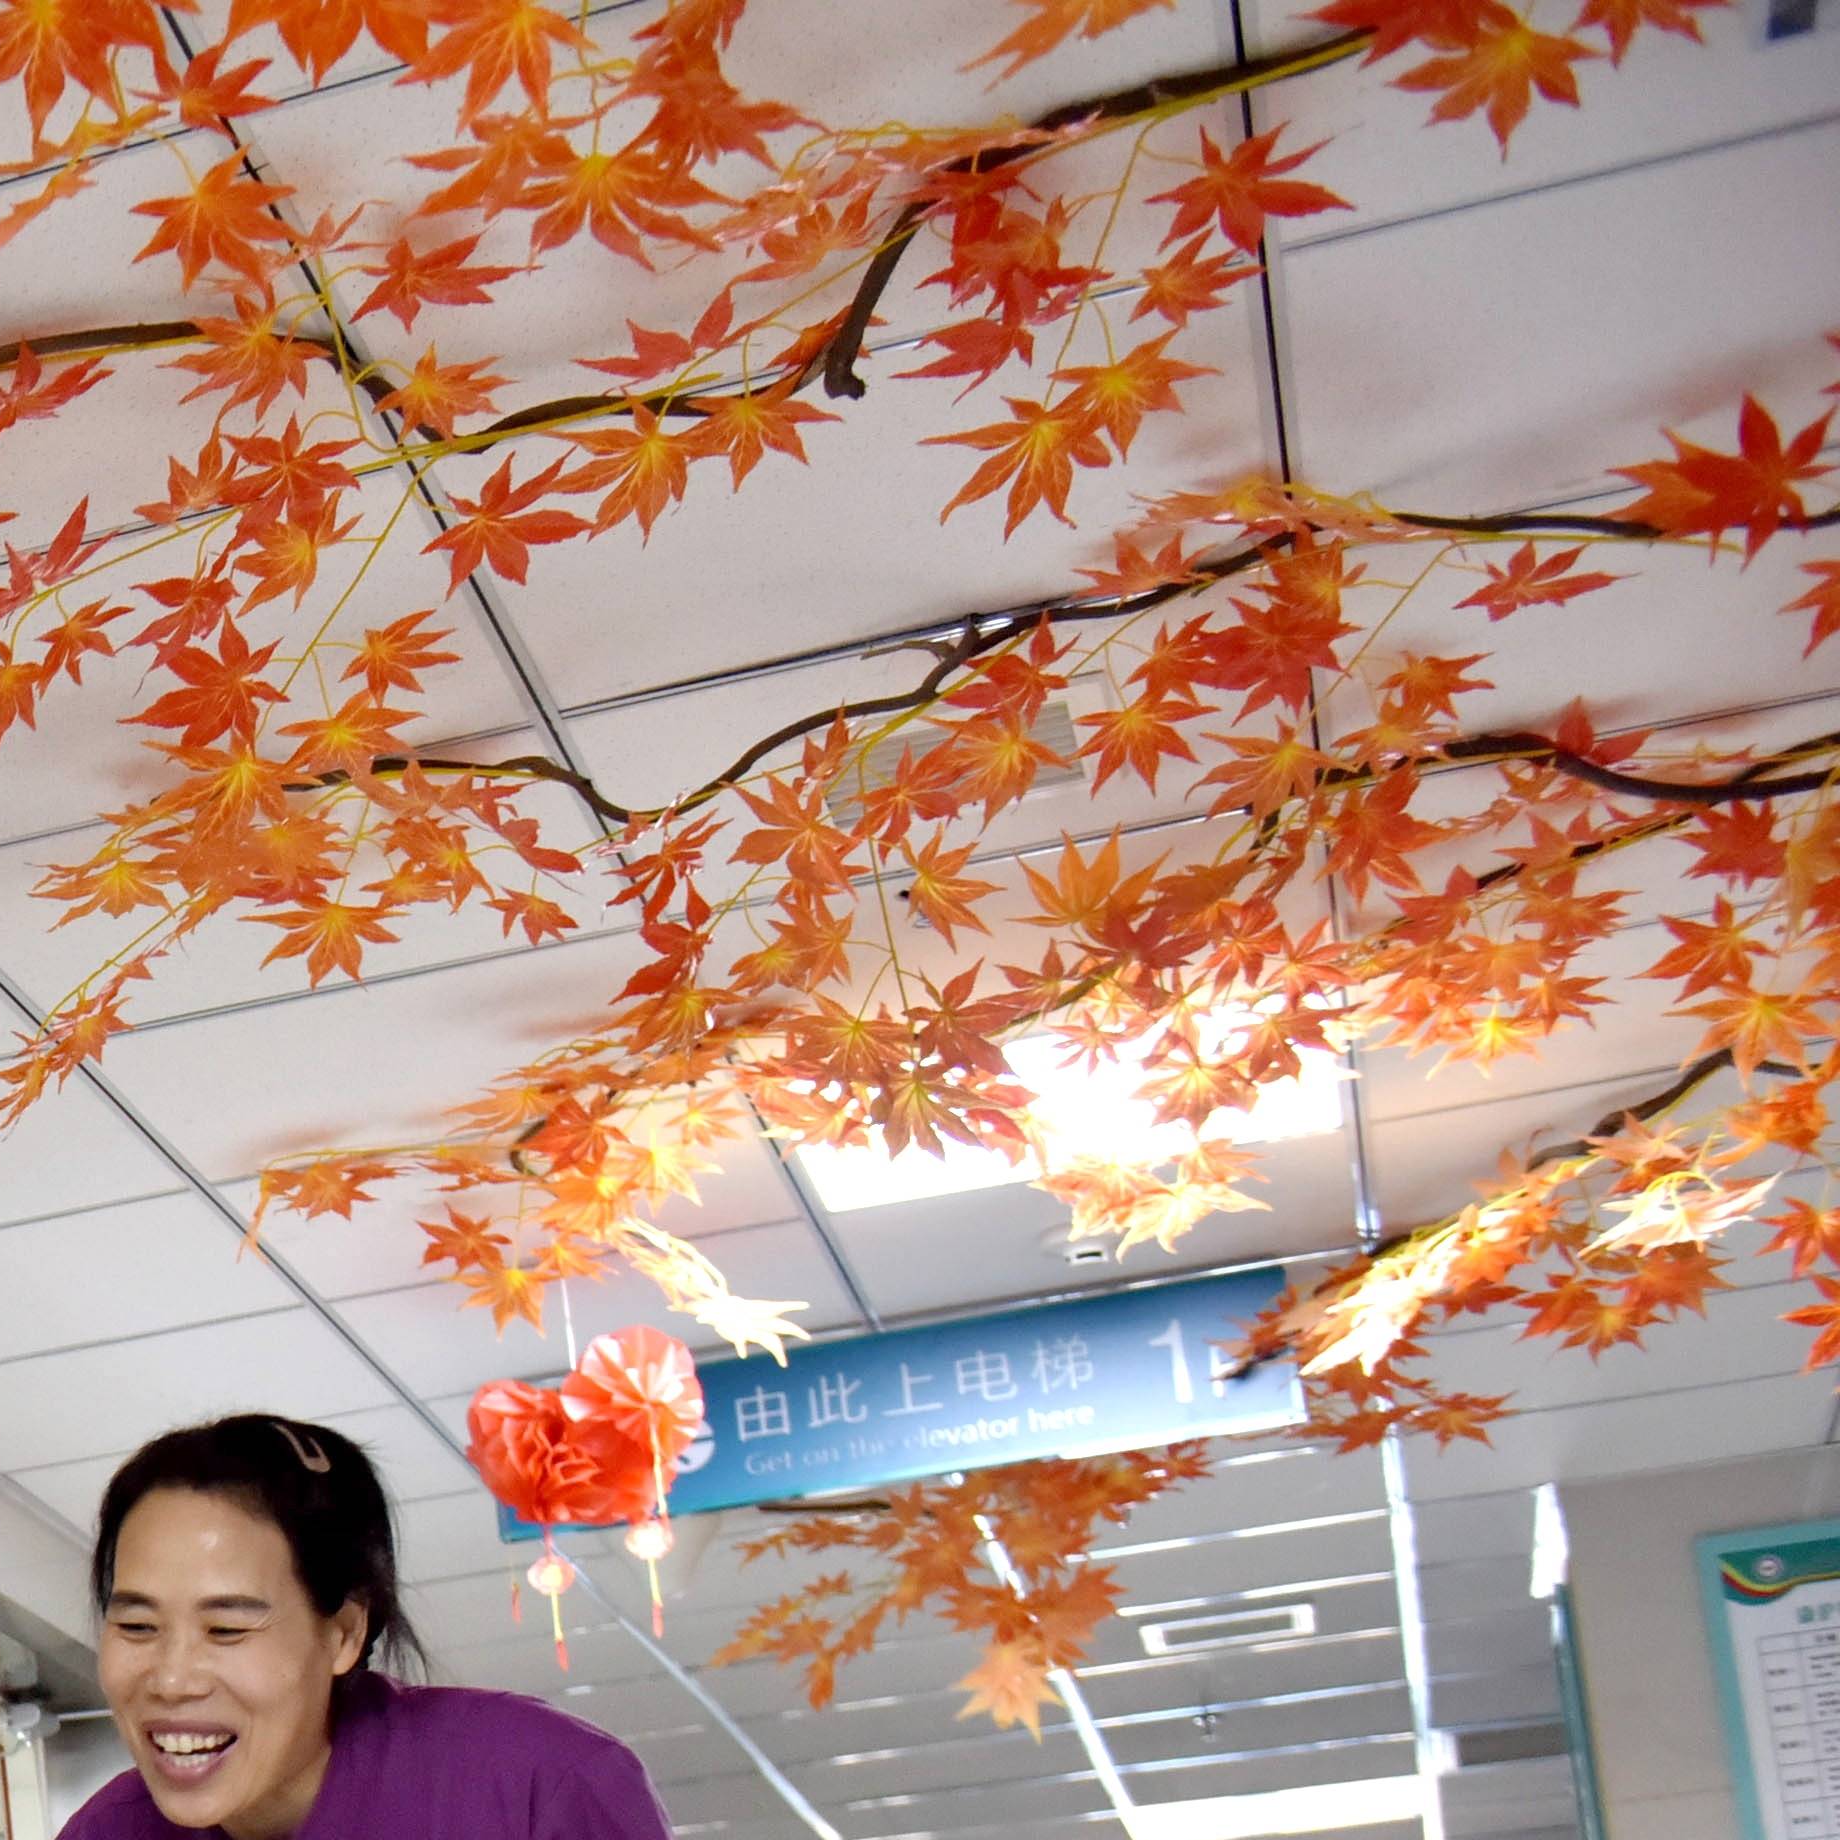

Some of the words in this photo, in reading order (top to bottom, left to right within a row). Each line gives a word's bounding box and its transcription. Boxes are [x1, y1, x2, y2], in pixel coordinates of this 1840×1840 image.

[735, 1334, 1095, 1441] 由此上电梯
[744, 1448, 792, 1476] Get
[802, 1446, 840, 1468] on
[904, 1414, 1019, 1450] elevator
[1026, 1403, 1096, 1433] here
